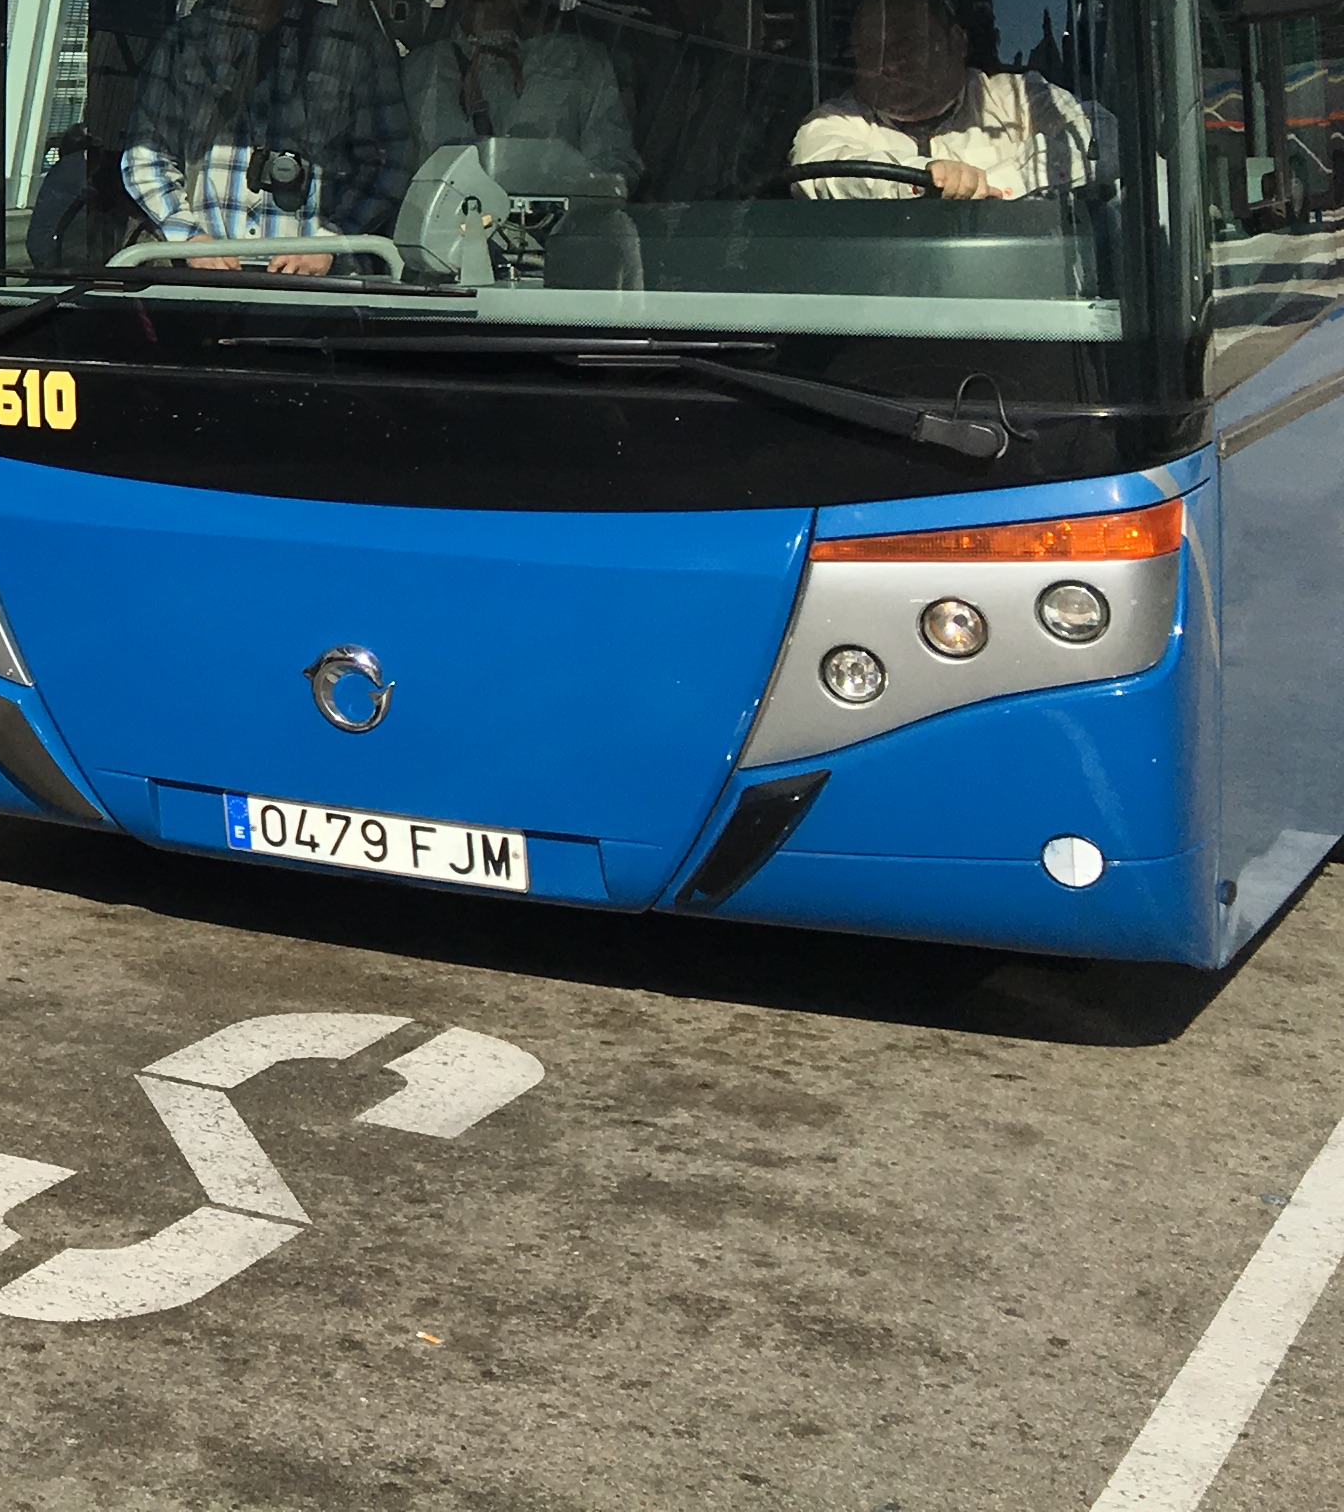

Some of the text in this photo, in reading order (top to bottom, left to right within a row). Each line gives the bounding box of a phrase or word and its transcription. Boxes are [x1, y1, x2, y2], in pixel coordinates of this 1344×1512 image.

[234, 804, 512, 882] E 0479 FJM
